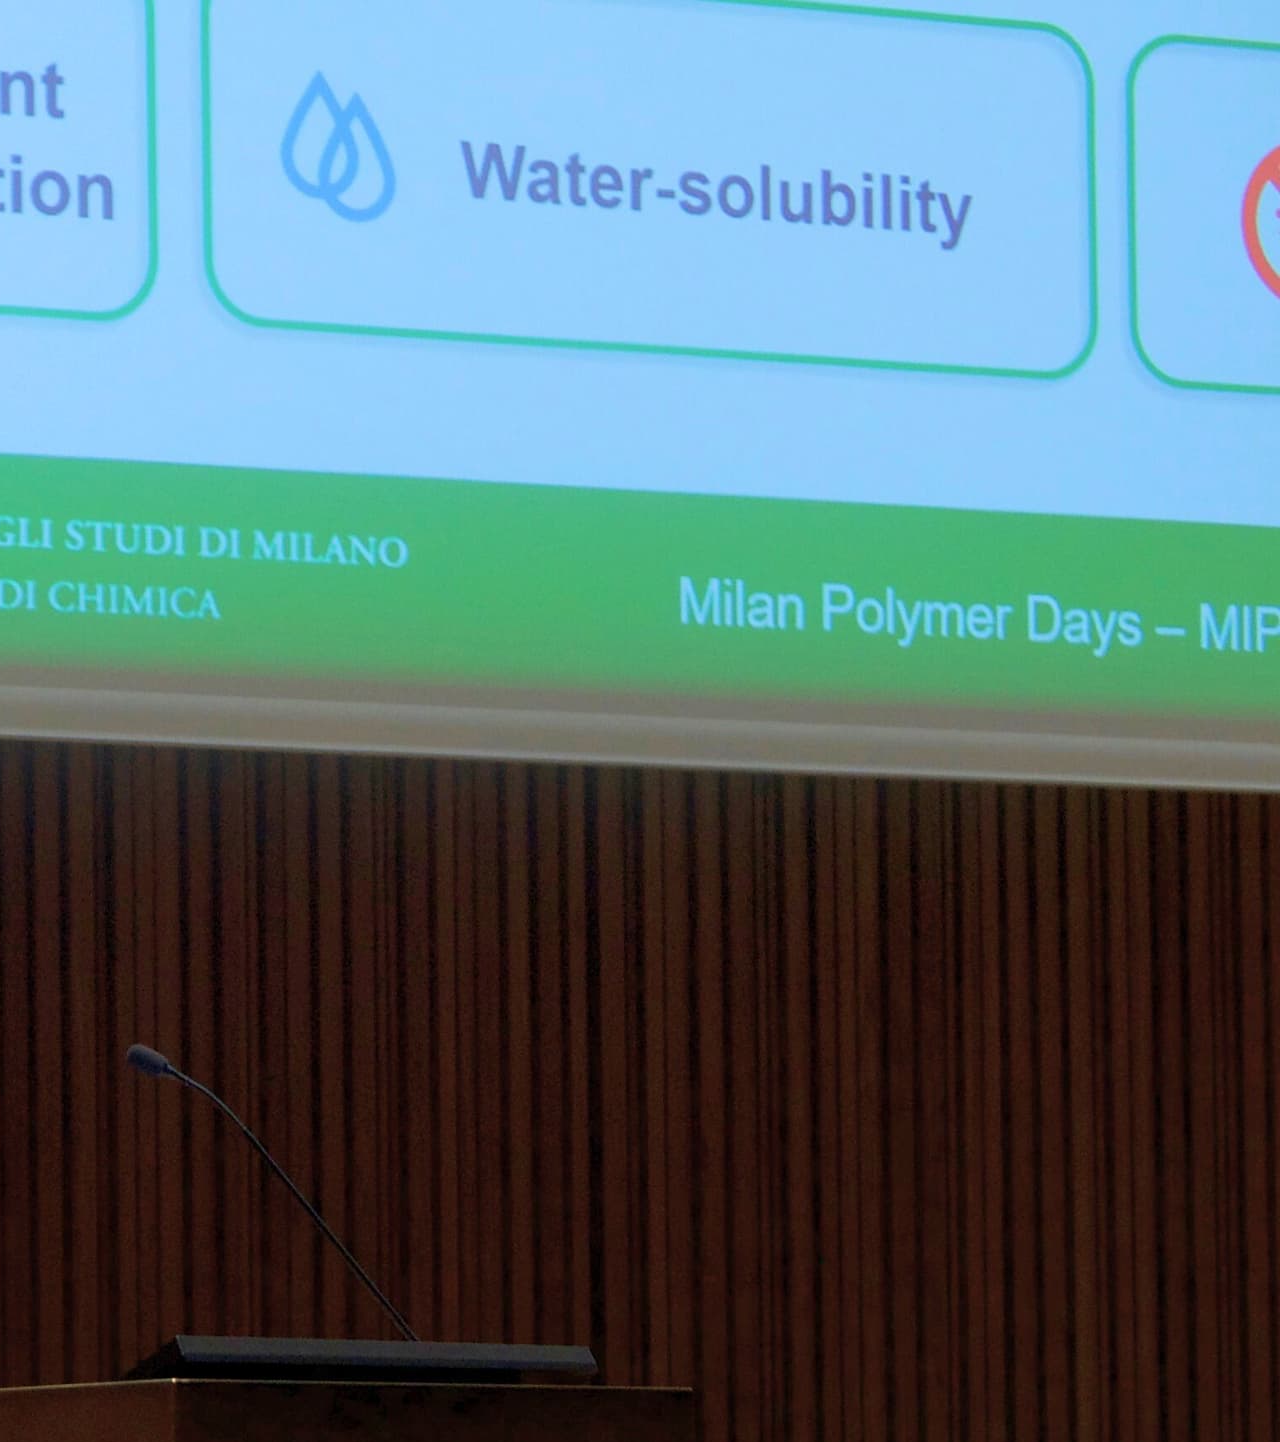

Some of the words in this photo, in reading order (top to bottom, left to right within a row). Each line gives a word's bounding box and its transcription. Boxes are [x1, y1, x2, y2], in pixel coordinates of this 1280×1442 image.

[459, 140, 972, 251] Water-solubility
[66, 520, 185, 557] STUDI
[198, 526, 241, 560] DI
[252, 530, 410, 568] MILANO
[48, 580, 221, 620] CHIMICA
[678, 576, 806, 630] Milan
[822, 582, 1012, 647] Polymer
[1028, 593, 1142, 657] Days
